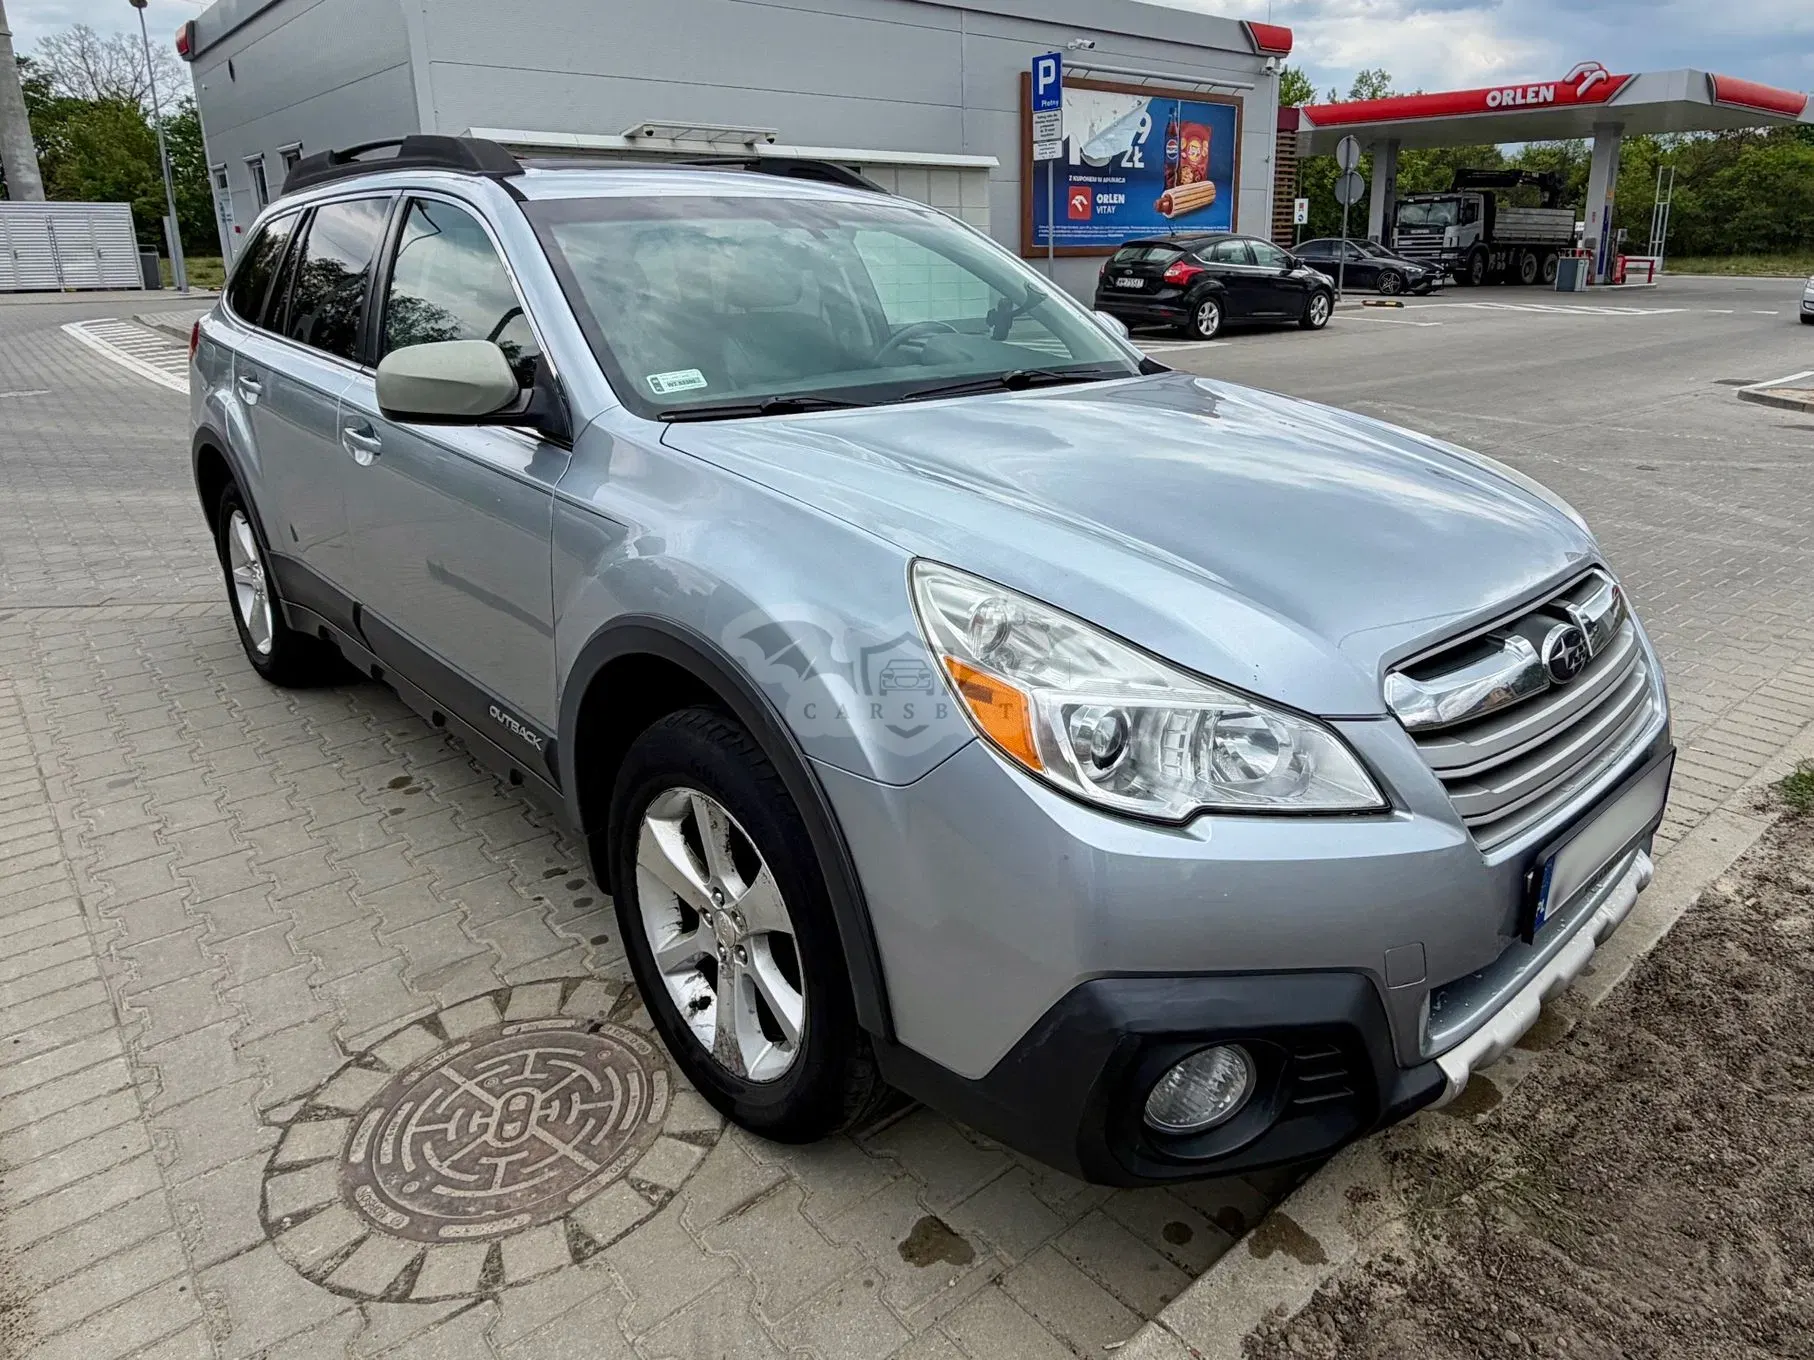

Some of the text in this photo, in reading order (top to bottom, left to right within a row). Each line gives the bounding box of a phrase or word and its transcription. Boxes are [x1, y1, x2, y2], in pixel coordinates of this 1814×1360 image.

[1038, 58, 1056, 95] P
[1485, 84, 1555, 107] ORLEN
[1096, 193, 1126, 204] ORLEN
[1096, 205, 1117, 215] VITAY
[489, 705, 542, 751] OUTBACK
